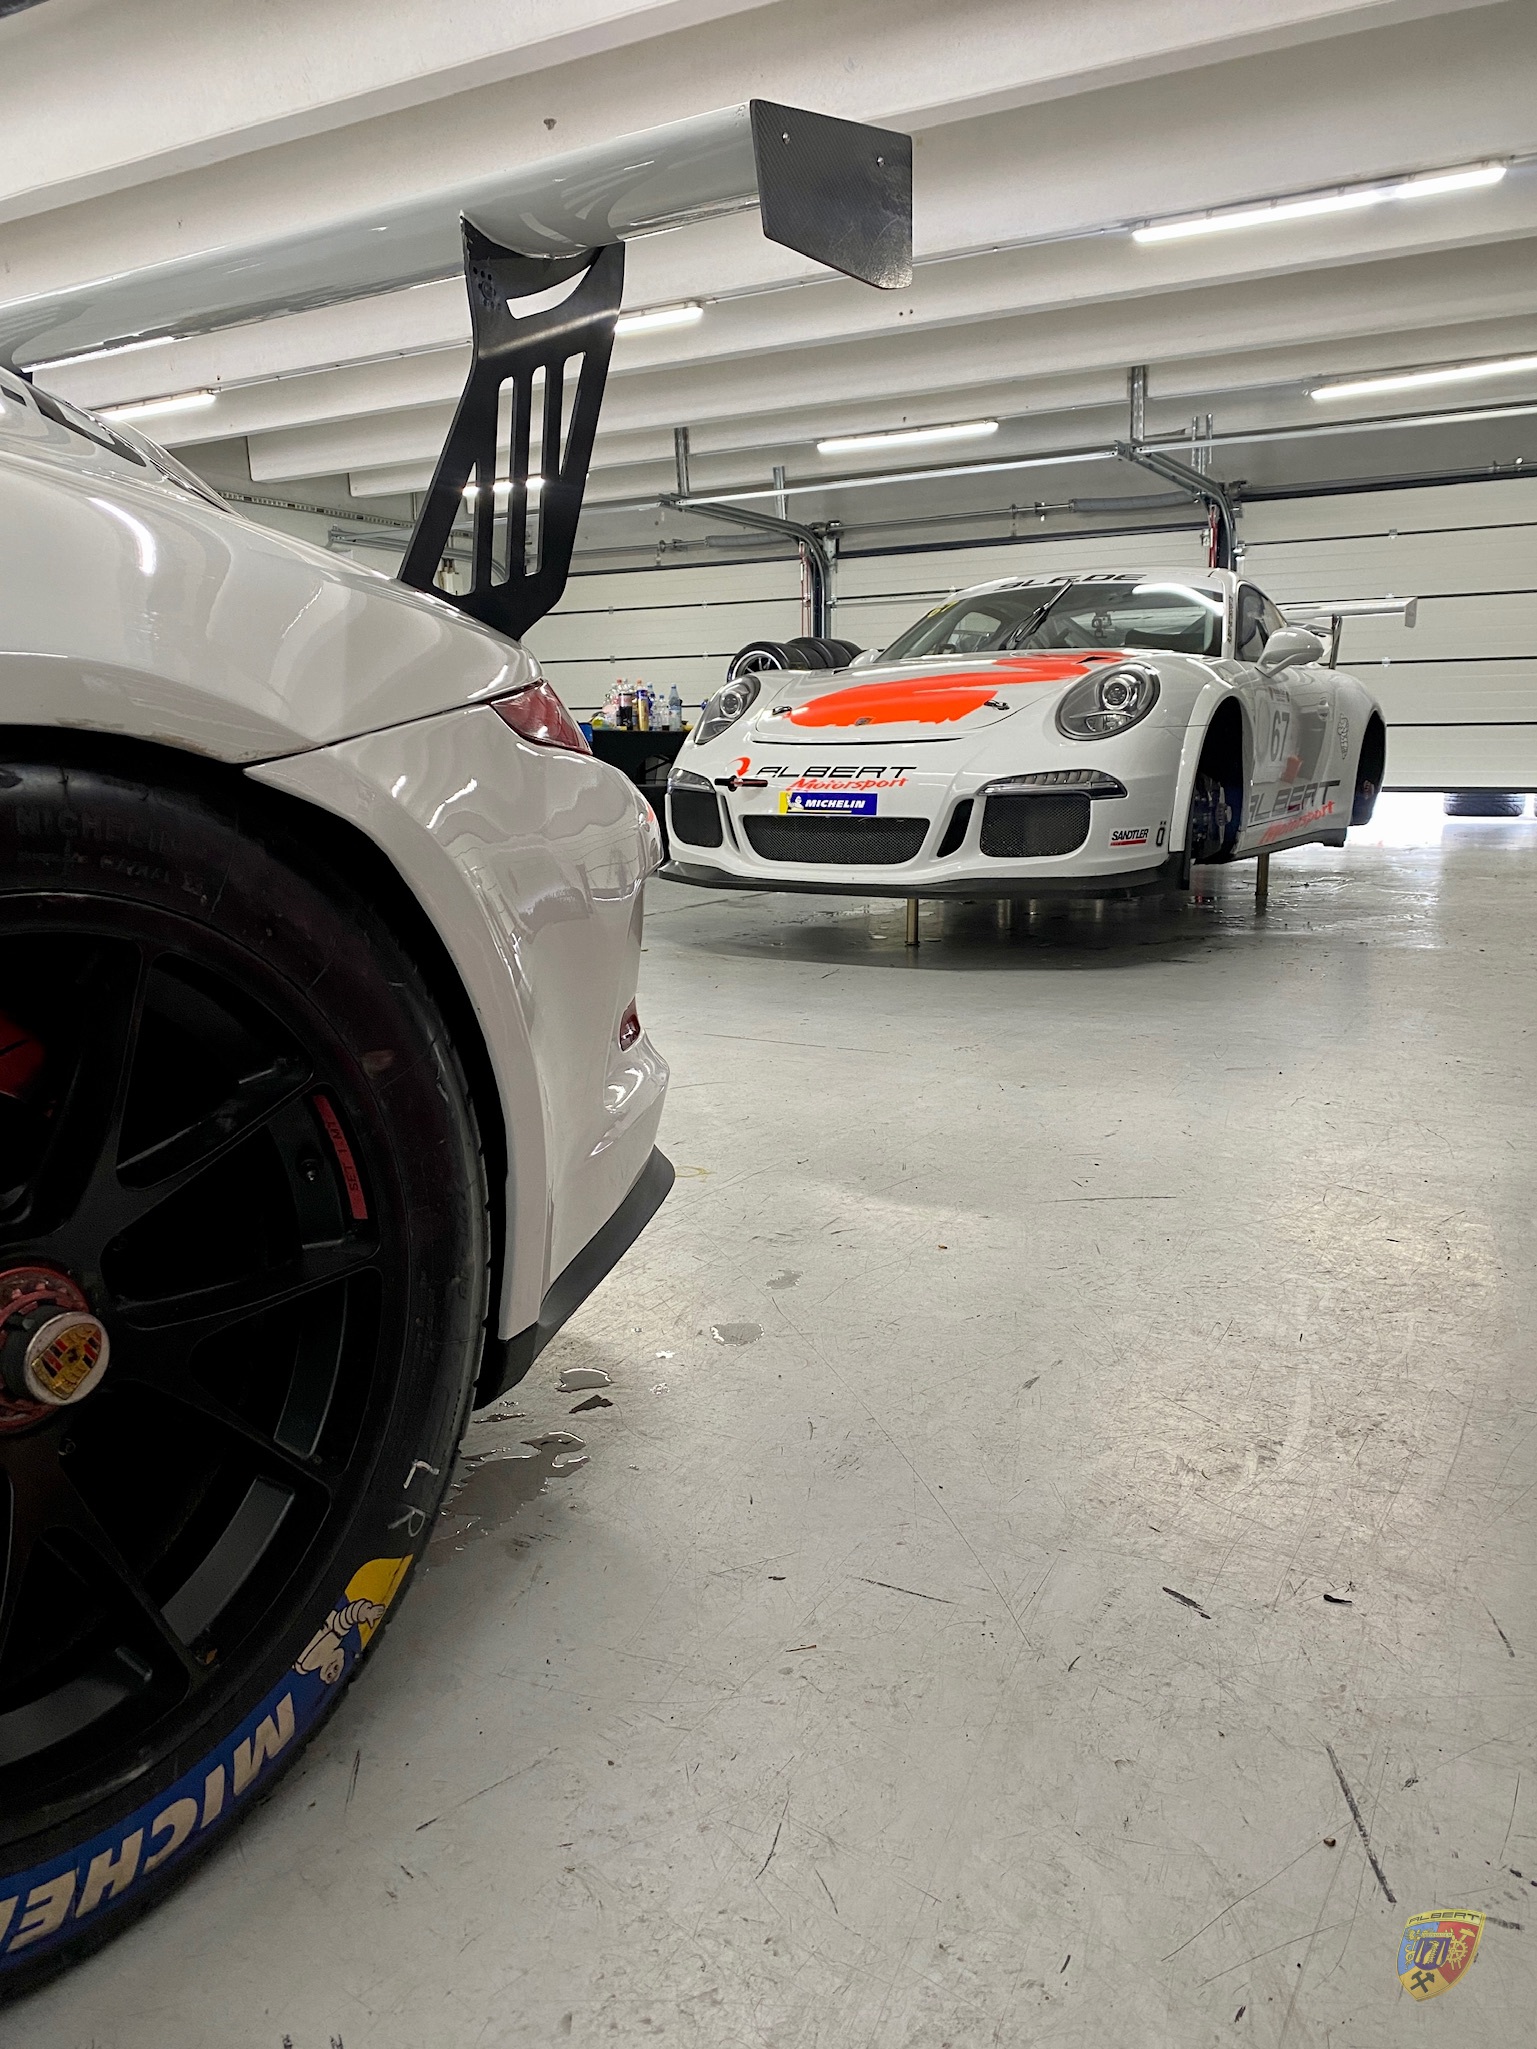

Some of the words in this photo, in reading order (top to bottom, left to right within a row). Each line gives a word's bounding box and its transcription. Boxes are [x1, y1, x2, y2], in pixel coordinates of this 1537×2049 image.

[1270, 710, 1291, 762] 67
[755, 765, 917, 779] ALBERT
[785, 777, 910, 791] Motorsport
[804, 799, 867, 809] MICHELIN
[1111, 828, 1149, 841] SANDTLER
[343, 1163, 360, 1191] SET
